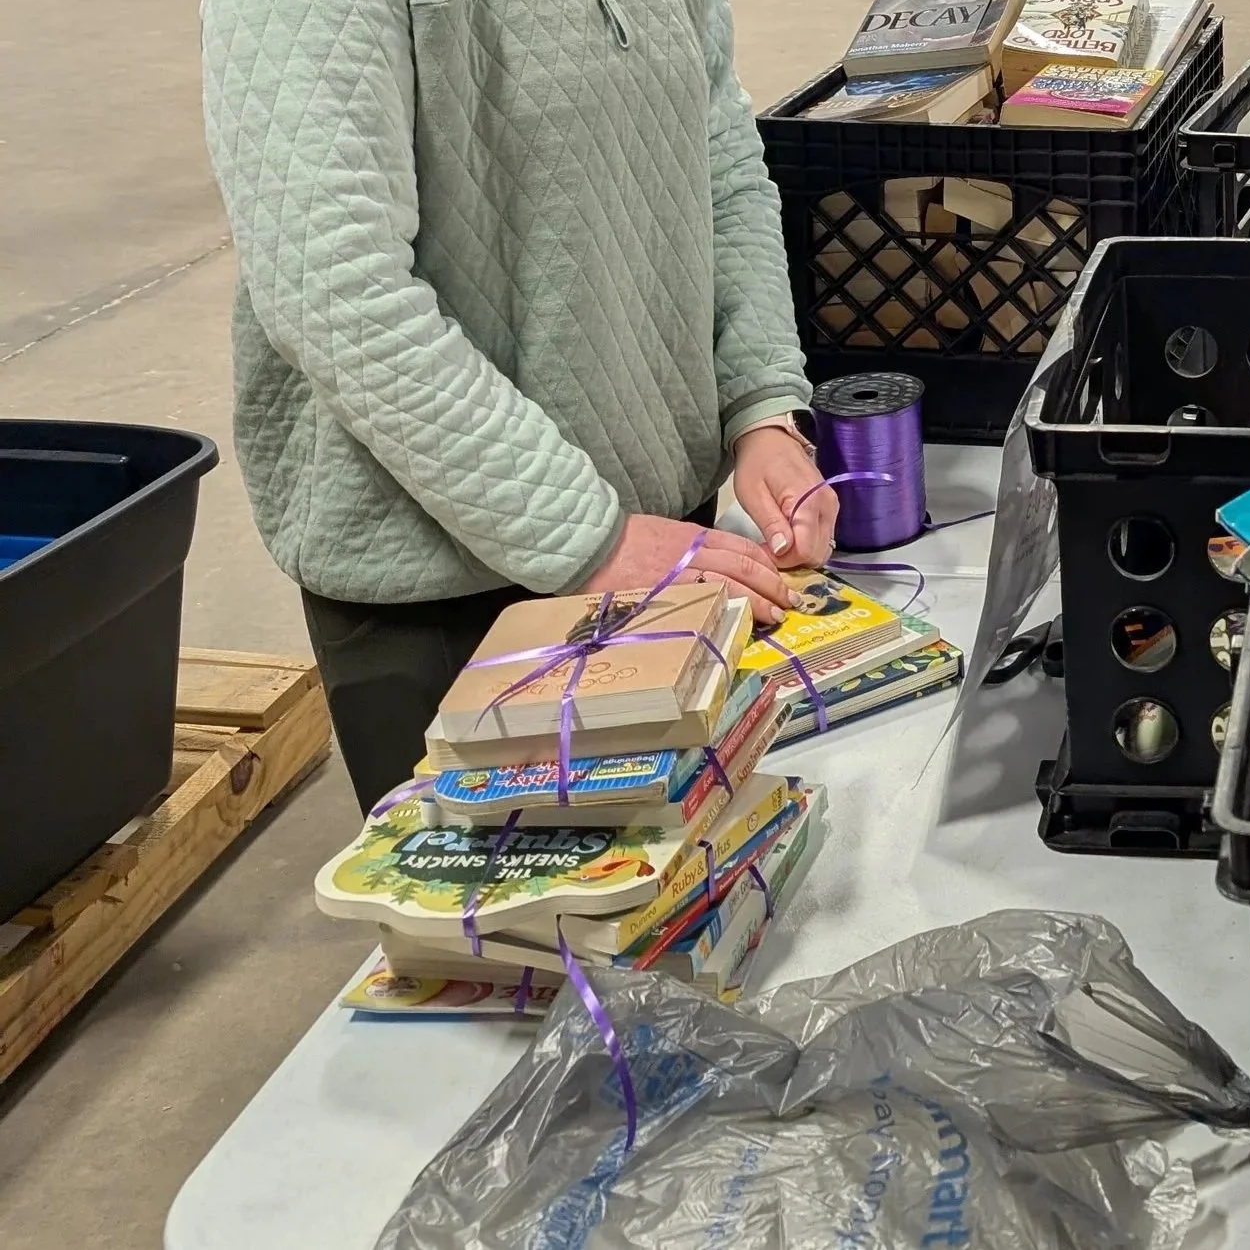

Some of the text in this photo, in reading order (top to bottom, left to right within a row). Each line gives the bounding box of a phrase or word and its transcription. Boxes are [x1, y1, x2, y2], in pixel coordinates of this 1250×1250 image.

[860, 4, 985, 33] DECAY
[1042, 29, 1095, 40] LORD
[890, 41, 929, 50] Maberry
[402, 827, 612, 854] Squirrel
[399, 853, 488, 869] SNACKY
[495, 867, 532, 880] THE
[666, 867, 700, 900] Ruby
[626, 903, 659, 935] Dunrea
